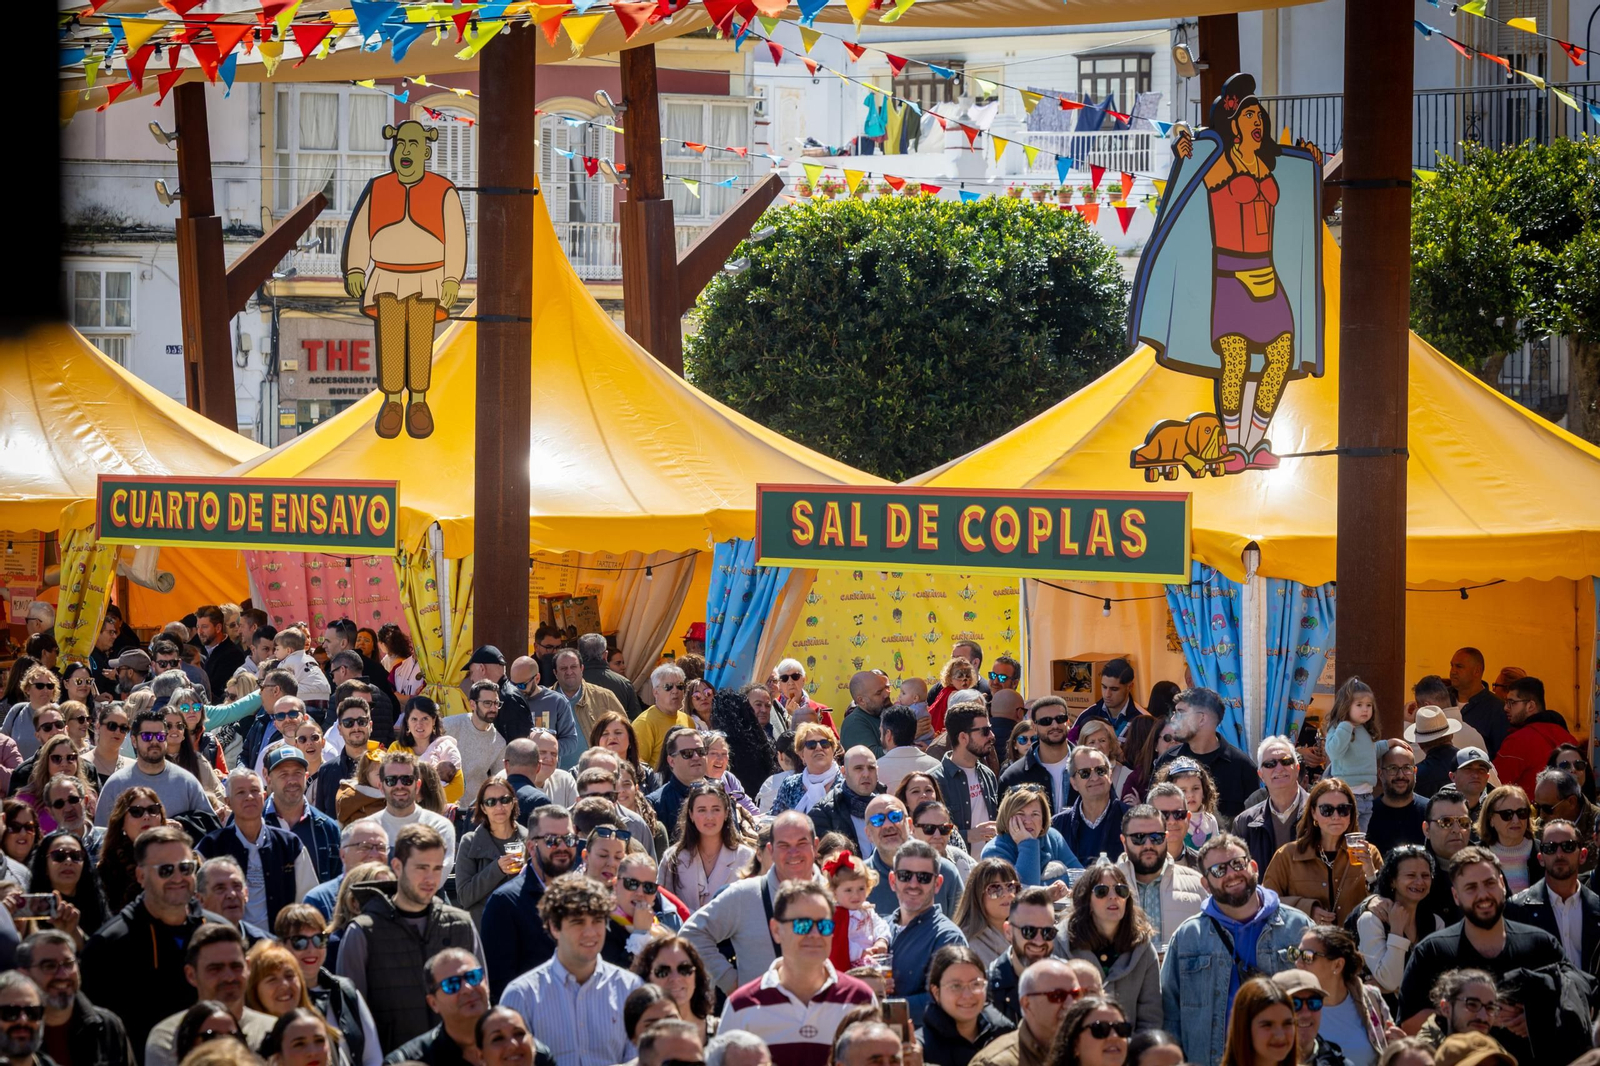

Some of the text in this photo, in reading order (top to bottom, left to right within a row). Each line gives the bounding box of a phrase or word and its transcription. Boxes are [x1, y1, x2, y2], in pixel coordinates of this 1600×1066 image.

[301, 340, 371, 371] THE
[309, 376, 364, 385] ACCESORIOS
[365, 376, 372, 384] Y
[328, 387, 369, 395] MOVILES
[110, 489, 391, 536] CUARTO DE ENSAYO
[792, 500, 1147, 558] SAL DE COPLAS
